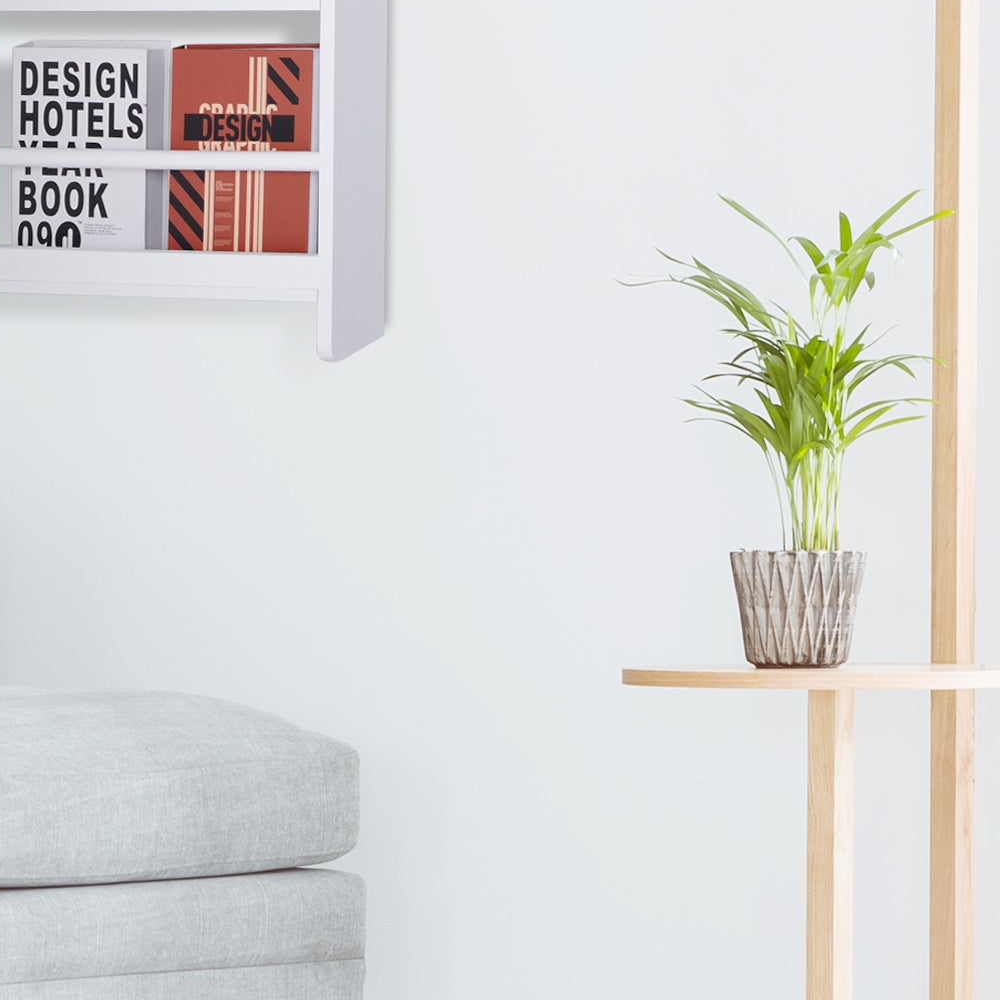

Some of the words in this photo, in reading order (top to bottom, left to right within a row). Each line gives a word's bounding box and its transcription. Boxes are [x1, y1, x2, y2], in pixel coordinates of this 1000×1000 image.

[20, 60, 139, 99] DESIGN
[19, 100, 144, 139] HOTELS
[198, 113, 275, 142] DESIGN
[18, 180, 109, 219] BOOK
